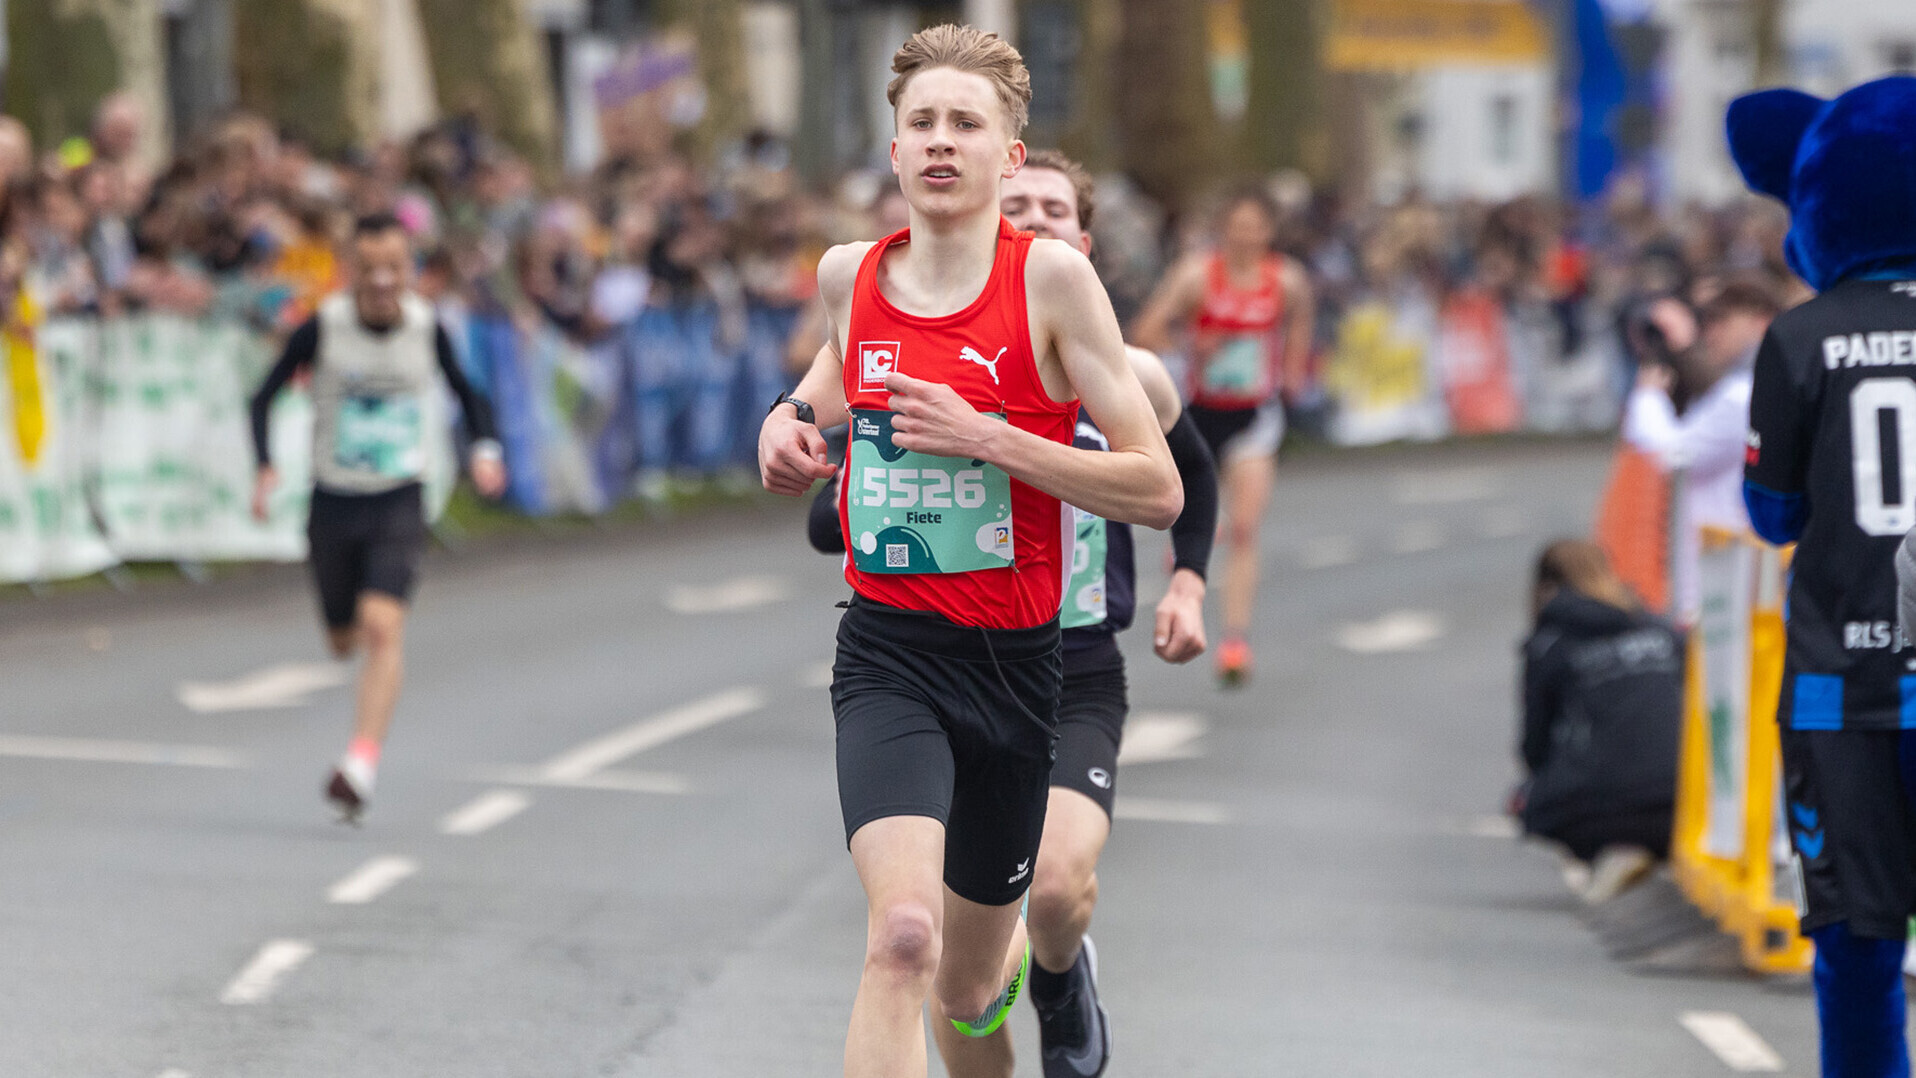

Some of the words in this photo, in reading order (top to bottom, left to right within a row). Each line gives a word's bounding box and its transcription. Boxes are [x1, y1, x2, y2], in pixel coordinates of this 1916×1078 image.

[1823, 332, 1916, 370] PADE
[863, 467, 986, 508] 5526
[907, 511, 942, 524] Fiete
[1844, 620, 1892, 648] RLS
